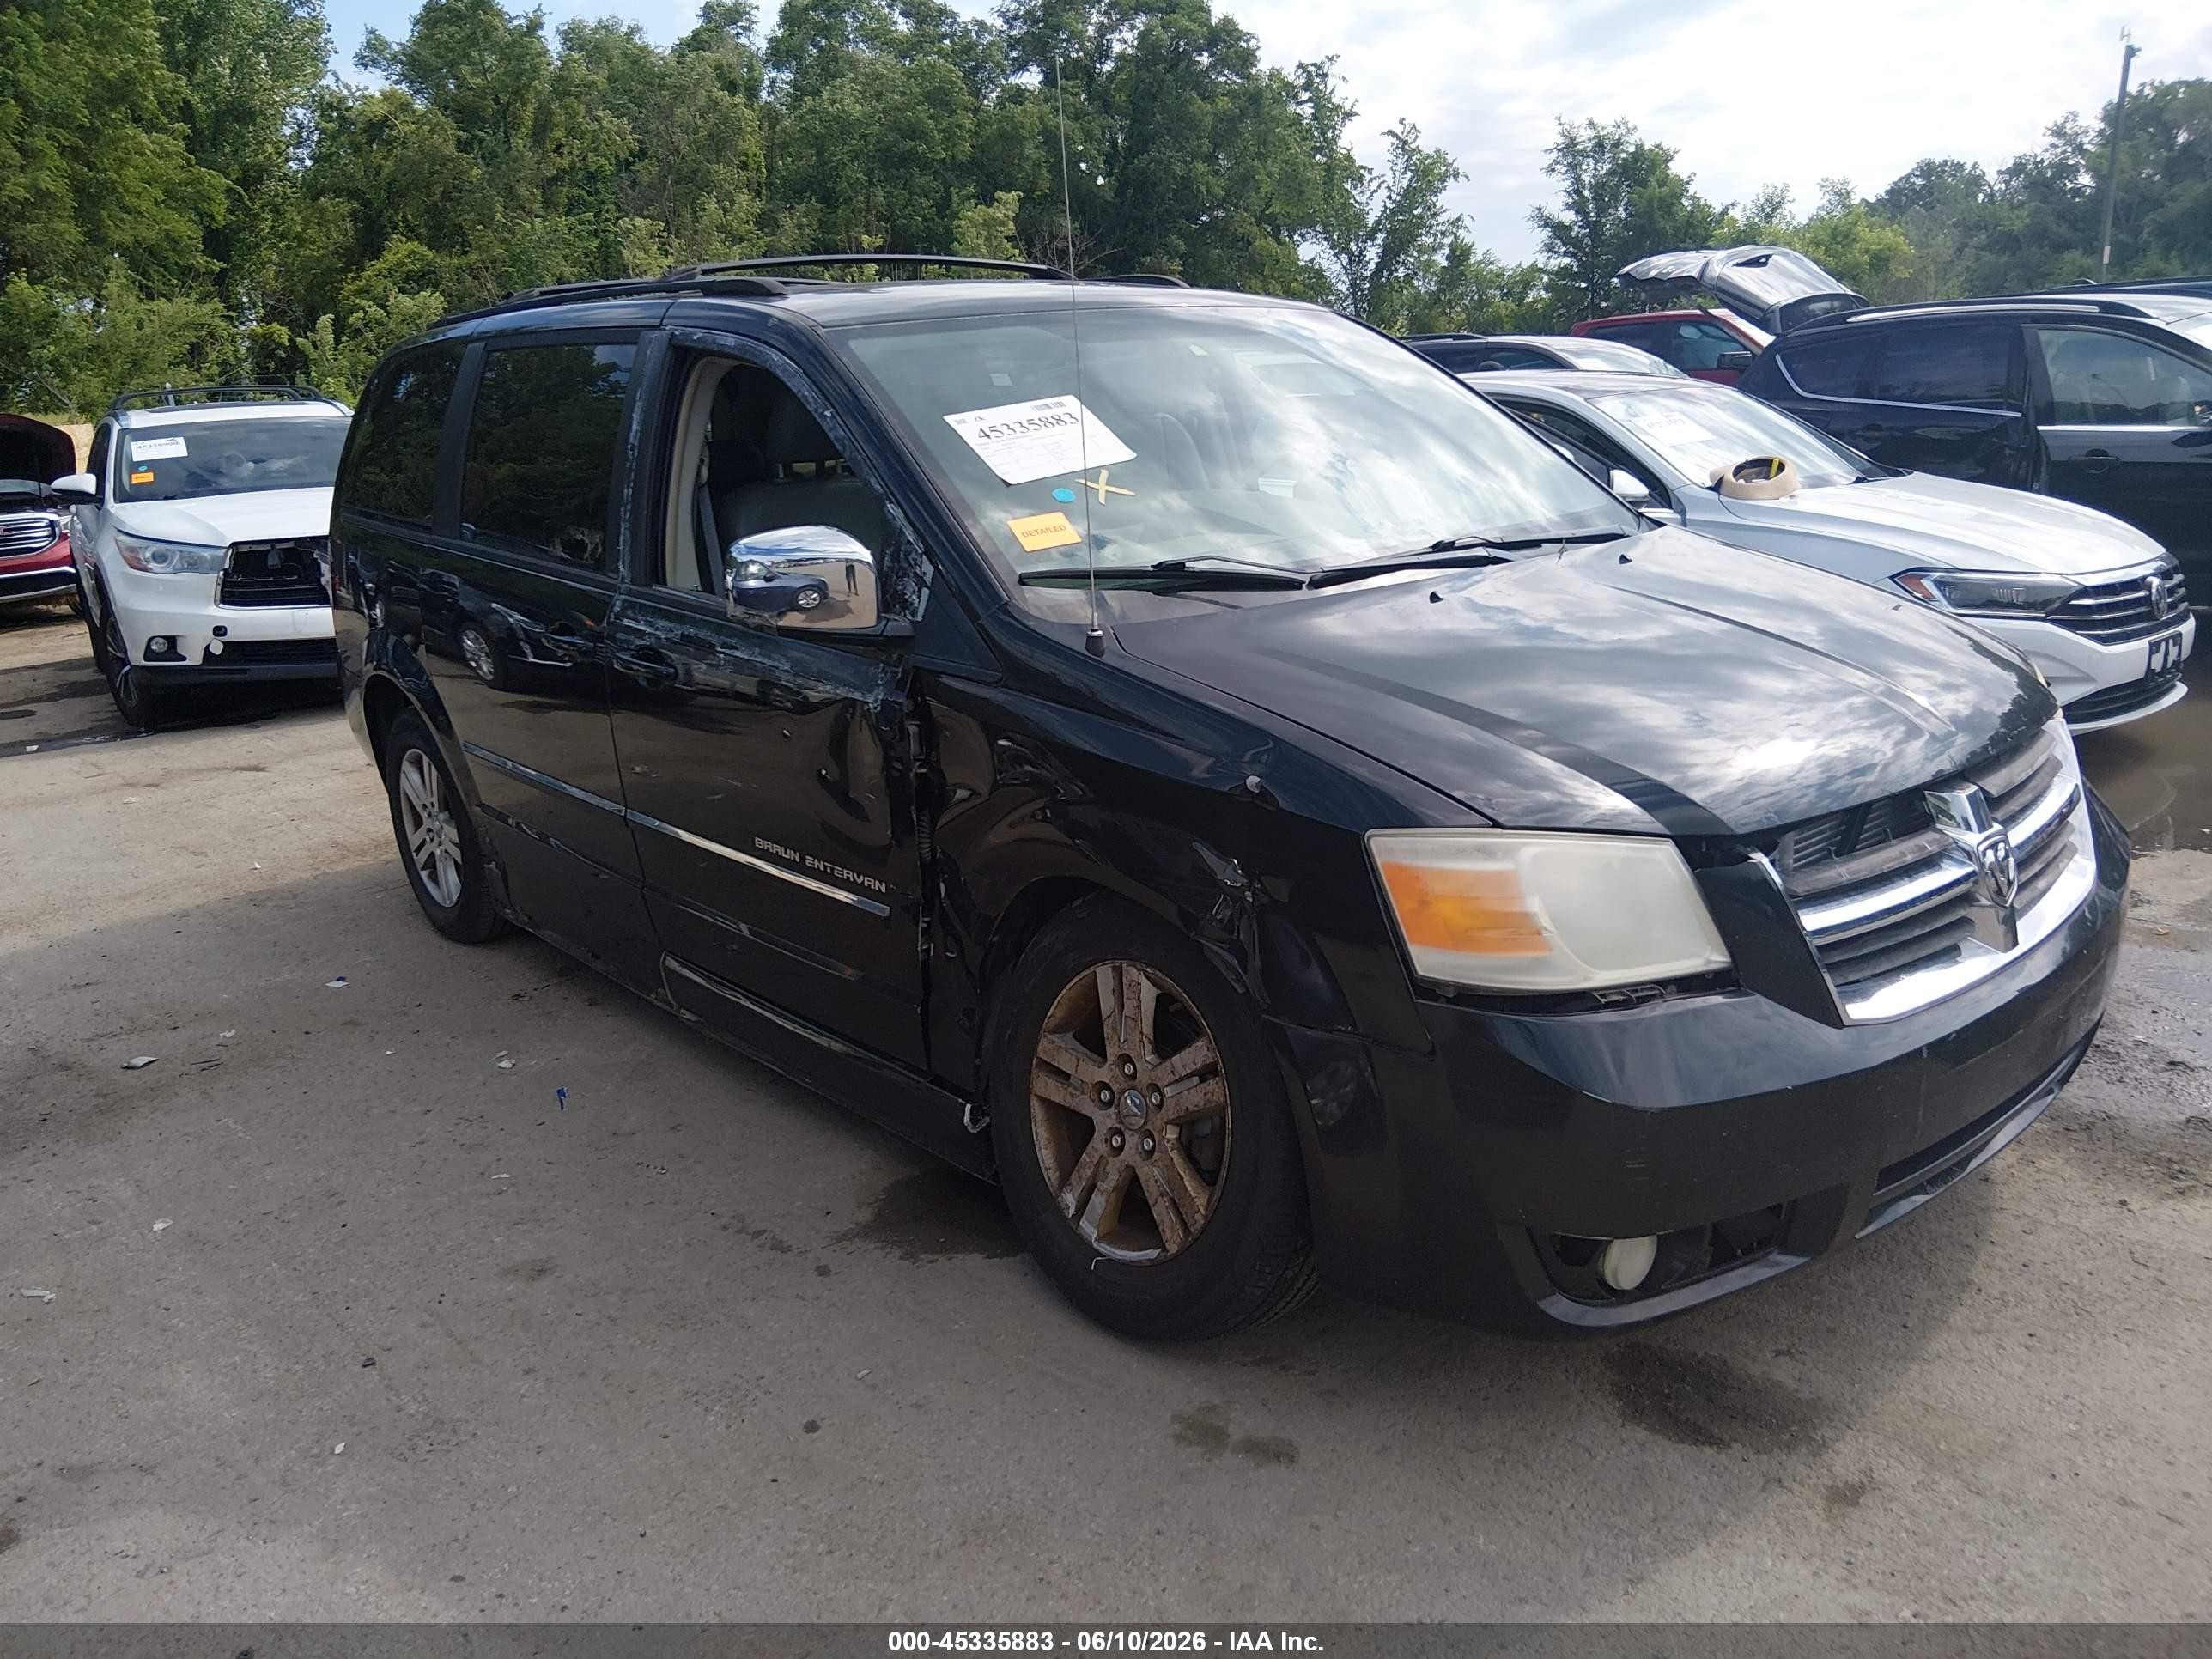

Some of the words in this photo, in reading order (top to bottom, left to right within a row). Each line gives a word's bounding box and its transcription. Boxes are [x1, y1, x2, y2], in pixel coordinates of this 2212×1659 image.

[978, 412, 1079, 440] 45335883
[1021, 525, 1067, 538] DETAILED
[754, 836, 800, 862] BRAUN
[805, 855, 887, 894] ENTERVAN
